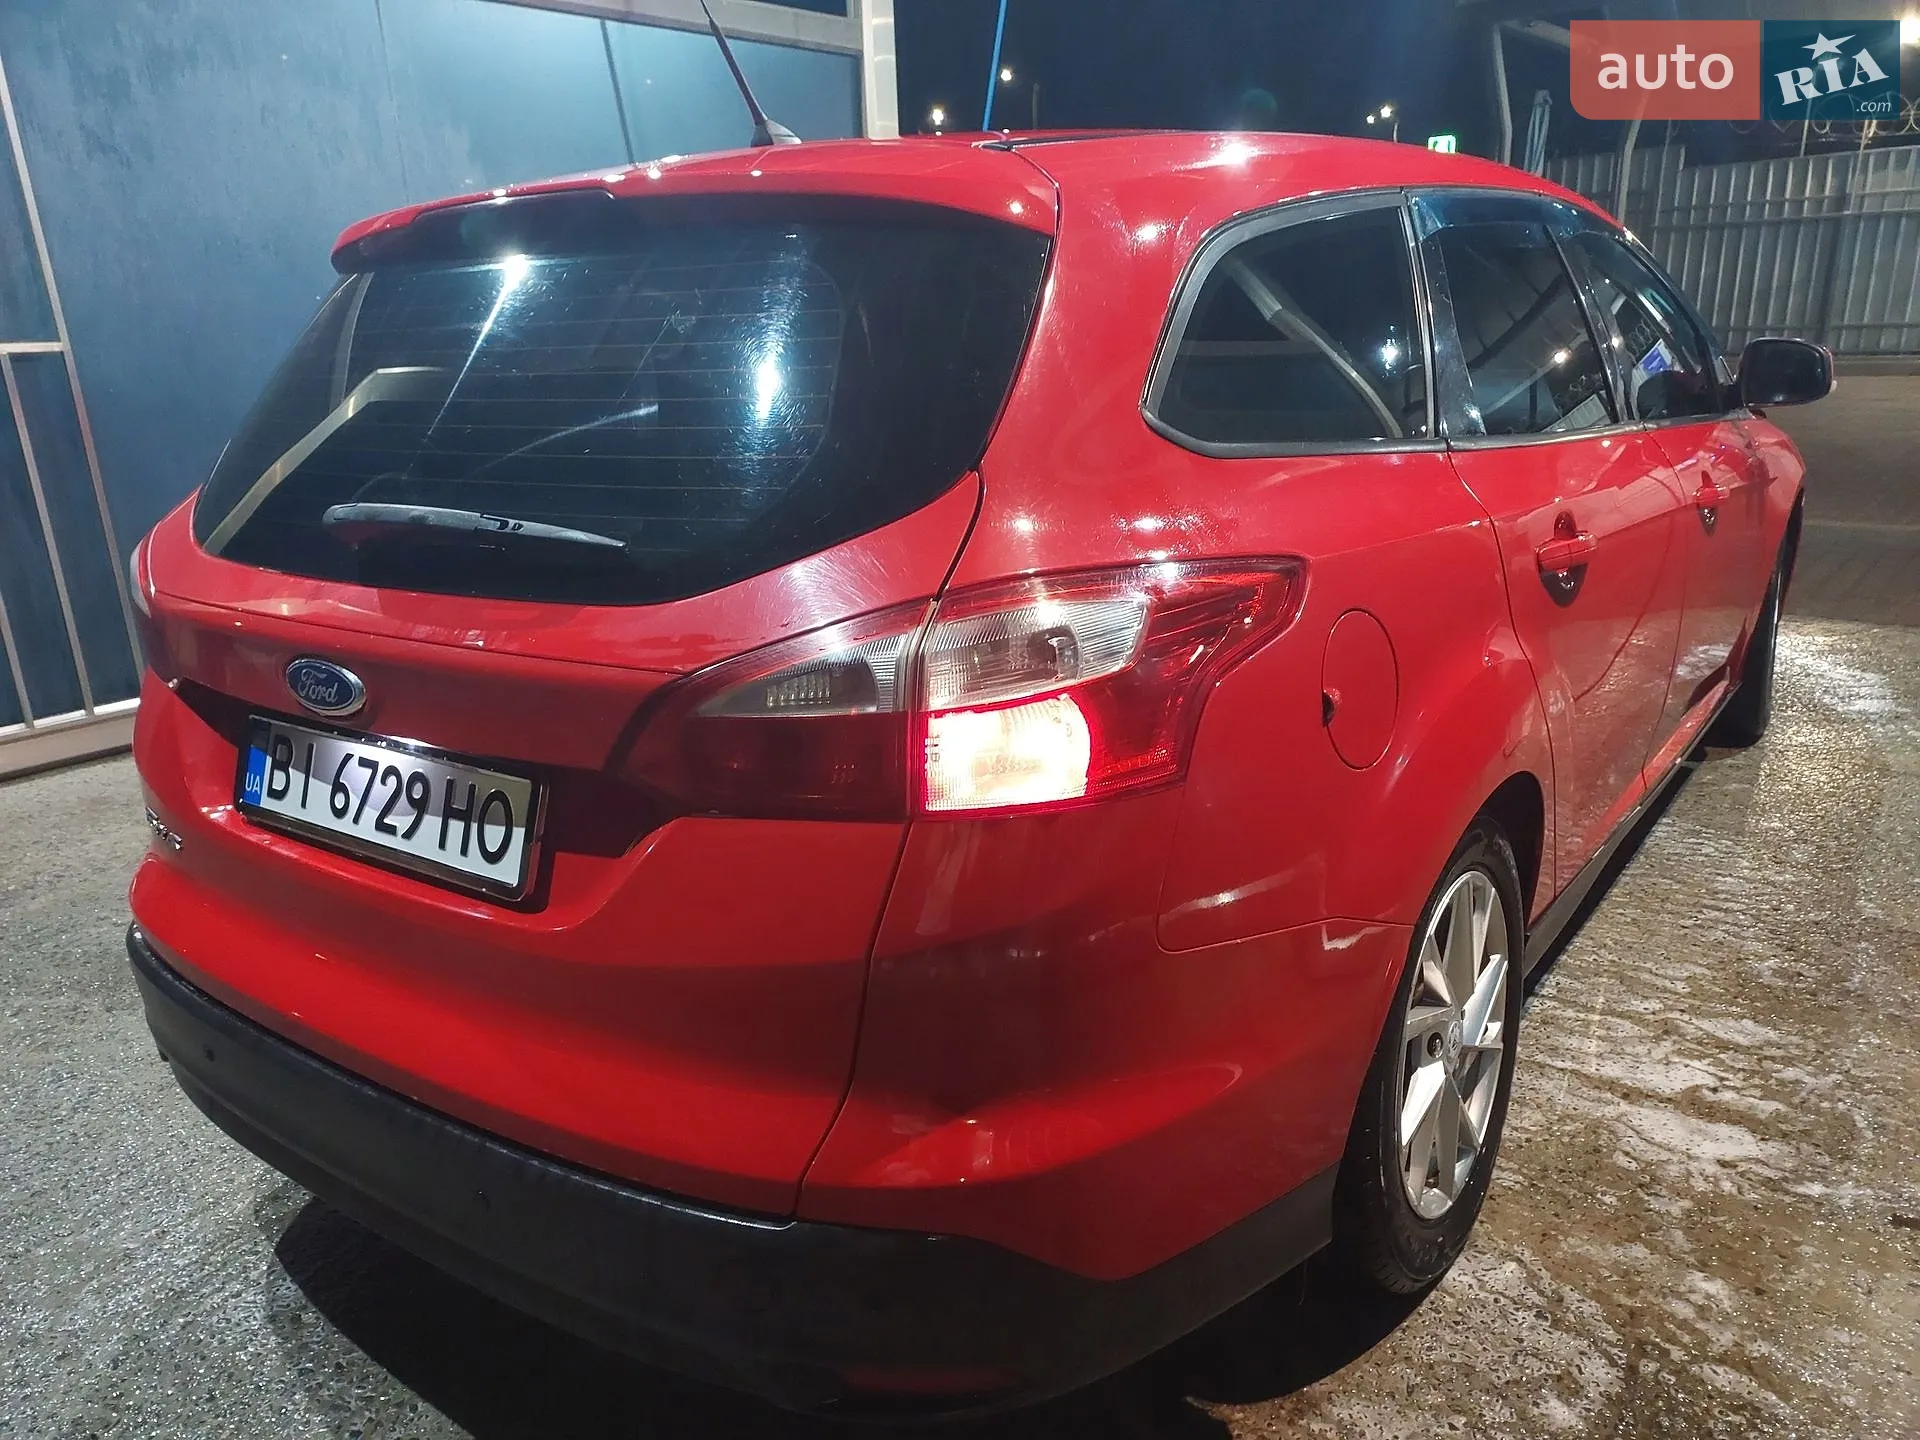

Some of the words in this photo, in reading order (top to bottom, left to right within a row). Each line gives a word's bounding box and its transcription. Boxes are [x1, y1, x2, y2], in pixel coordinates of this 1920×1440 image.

[298, 669, 339, 703] Ford
[245, 772, 261, 795] UA
[267, 734, 316, 809] BI
[330, 753, 431, 841] 6729
[438, 776, 514, 865] HO
